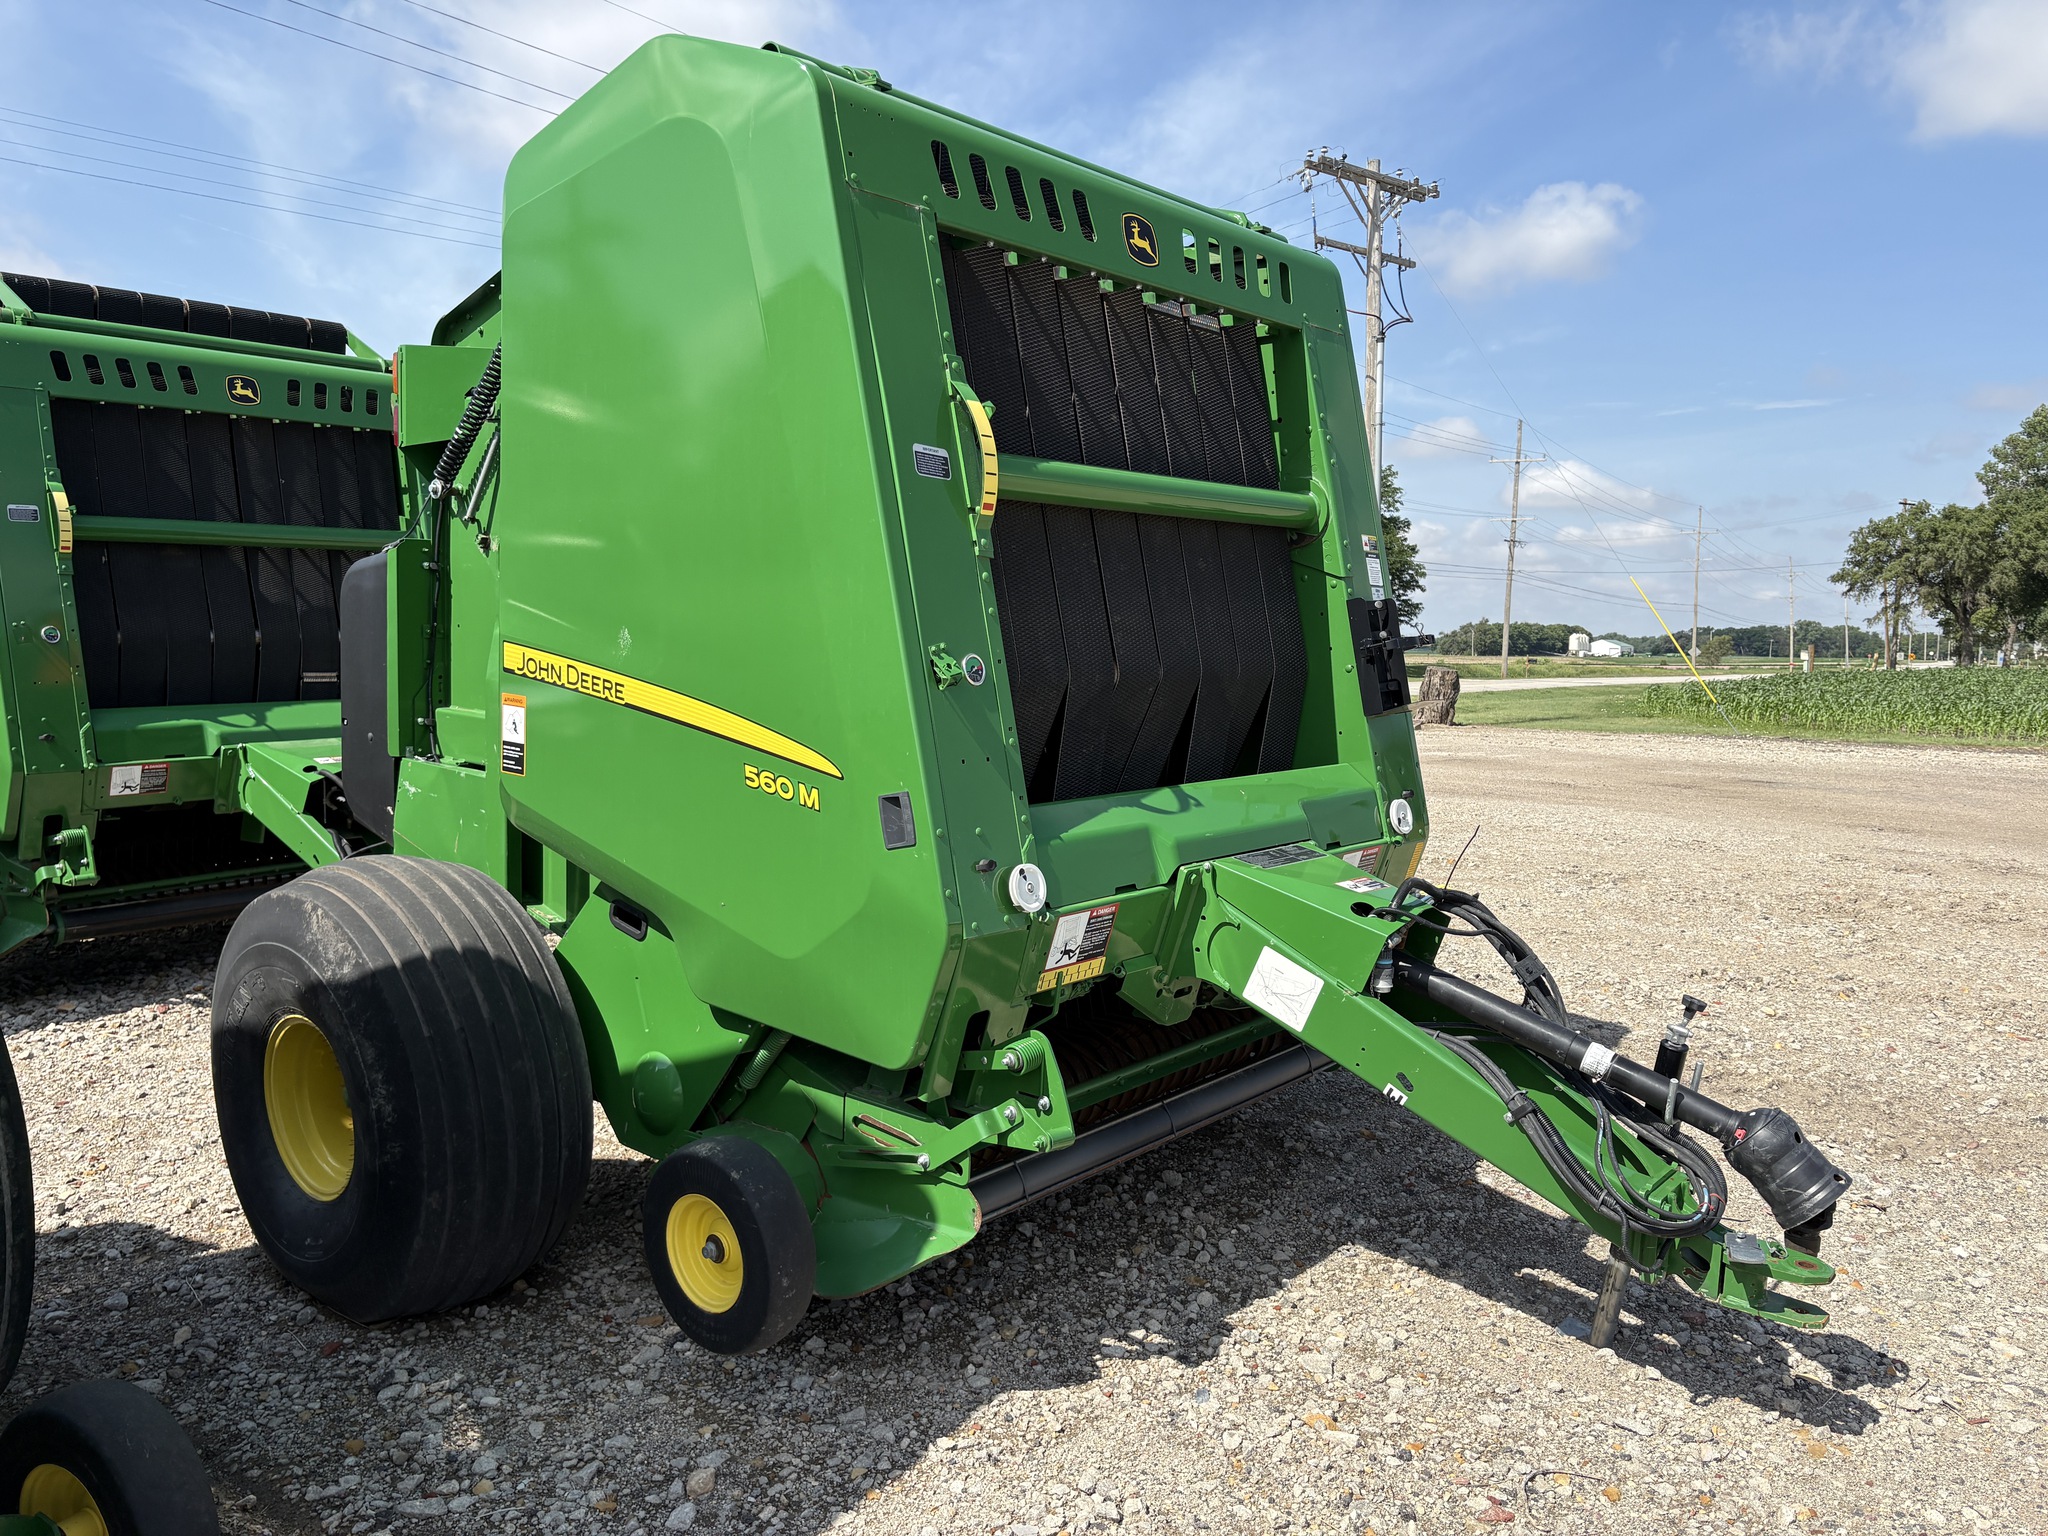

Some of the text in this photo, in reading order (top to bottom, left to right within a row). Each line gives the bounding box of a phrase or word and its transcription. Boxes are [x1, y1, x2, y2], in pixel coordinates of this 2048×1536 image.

[516, 652, 626, 701] JOHN DEERE
[744, 763, 821, 812] 560 M
[1097, 906, 1116, 916] DANGER
